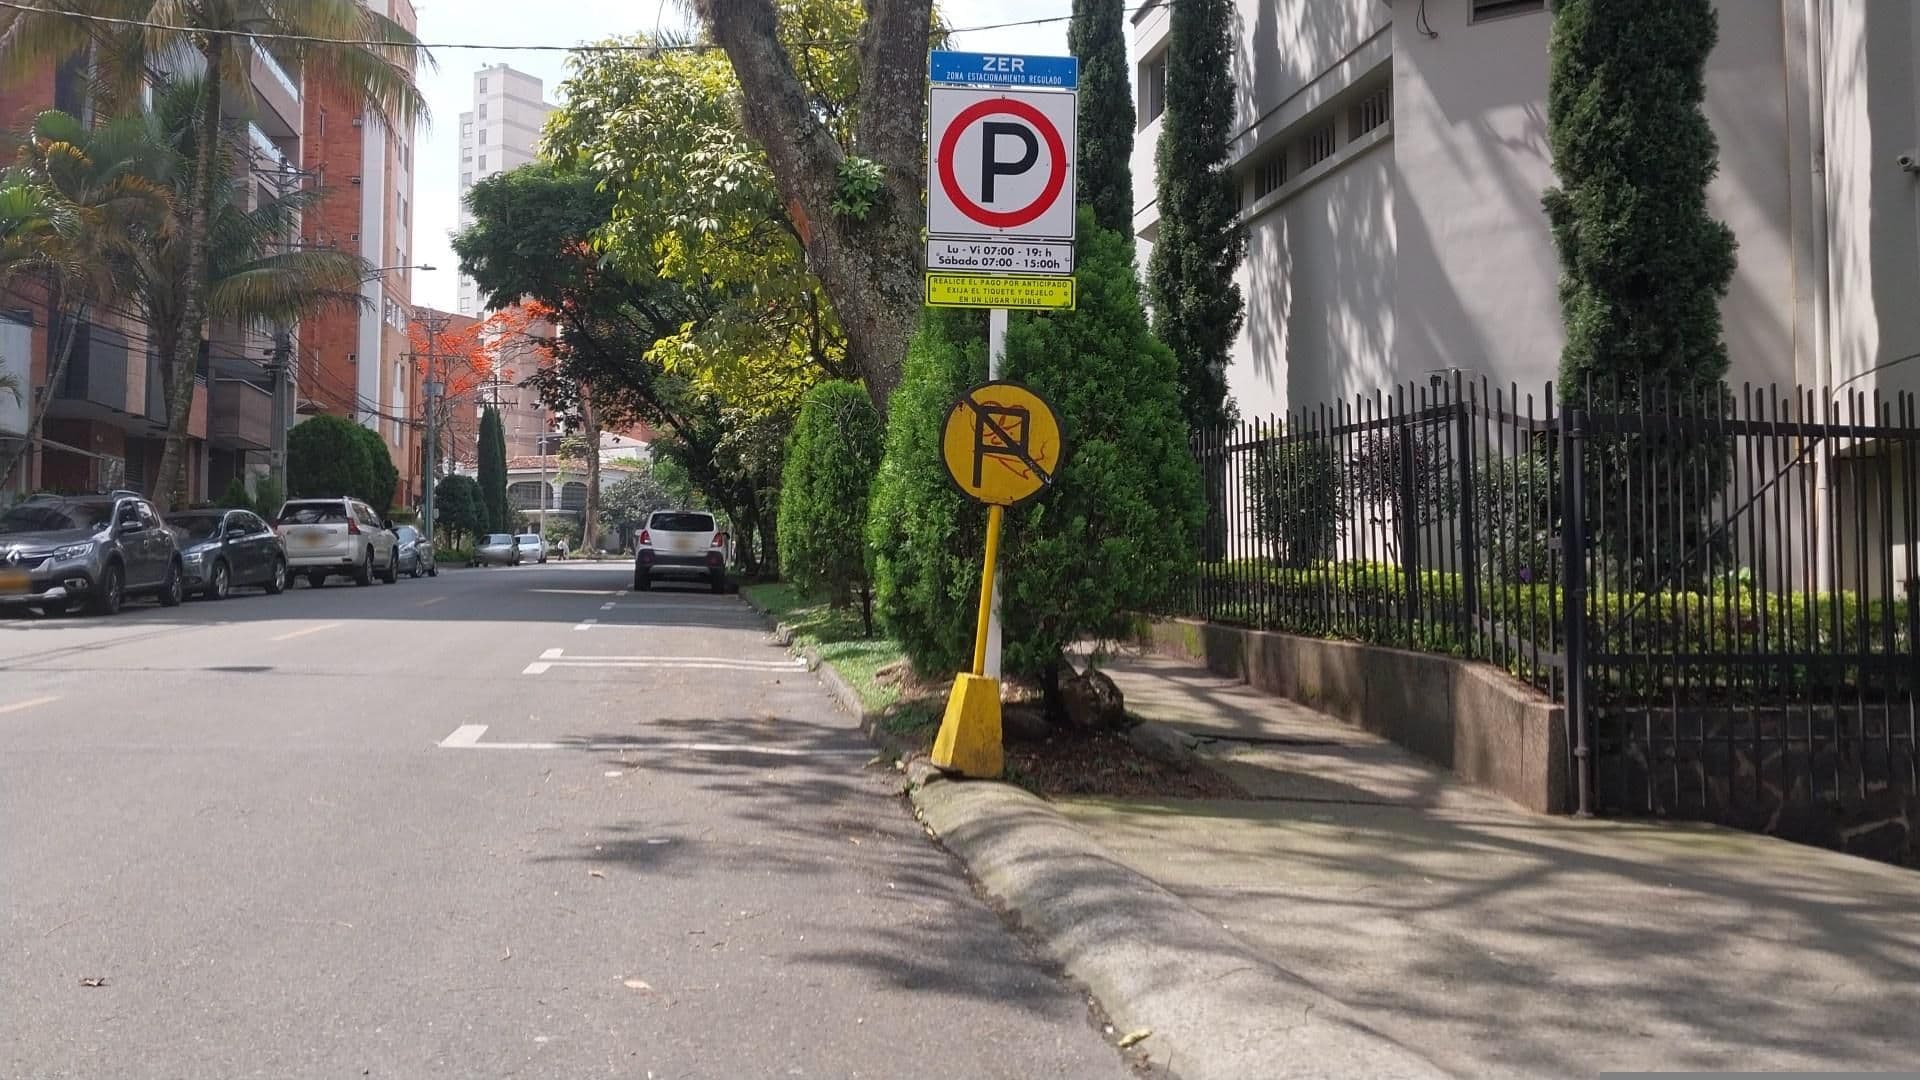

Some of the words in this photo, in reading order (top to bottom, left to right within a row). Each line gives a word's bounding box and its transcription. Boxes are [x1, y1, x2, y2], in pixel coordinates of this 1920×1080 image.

[983, 57, 1024, 72] ZER
[947, 72, 963, 80] ZONA
[968, 72, 1025, 82] ESTACIONAMIENTO
[1029, 75, 1061, 84] REGULADO
[982, 122, 1038, 203] P
[947, 245, 958, 253] Lu
[970, 245, 980, 254] Vi
[984, 247, 1014, 256] 07:00
[1046, 248, 1052, 256] h
[938, 256, 978, 266] Sábado
[982, 258, 1012, 267] 07:00
[1024, 259, 1060, 269] 15:00h
